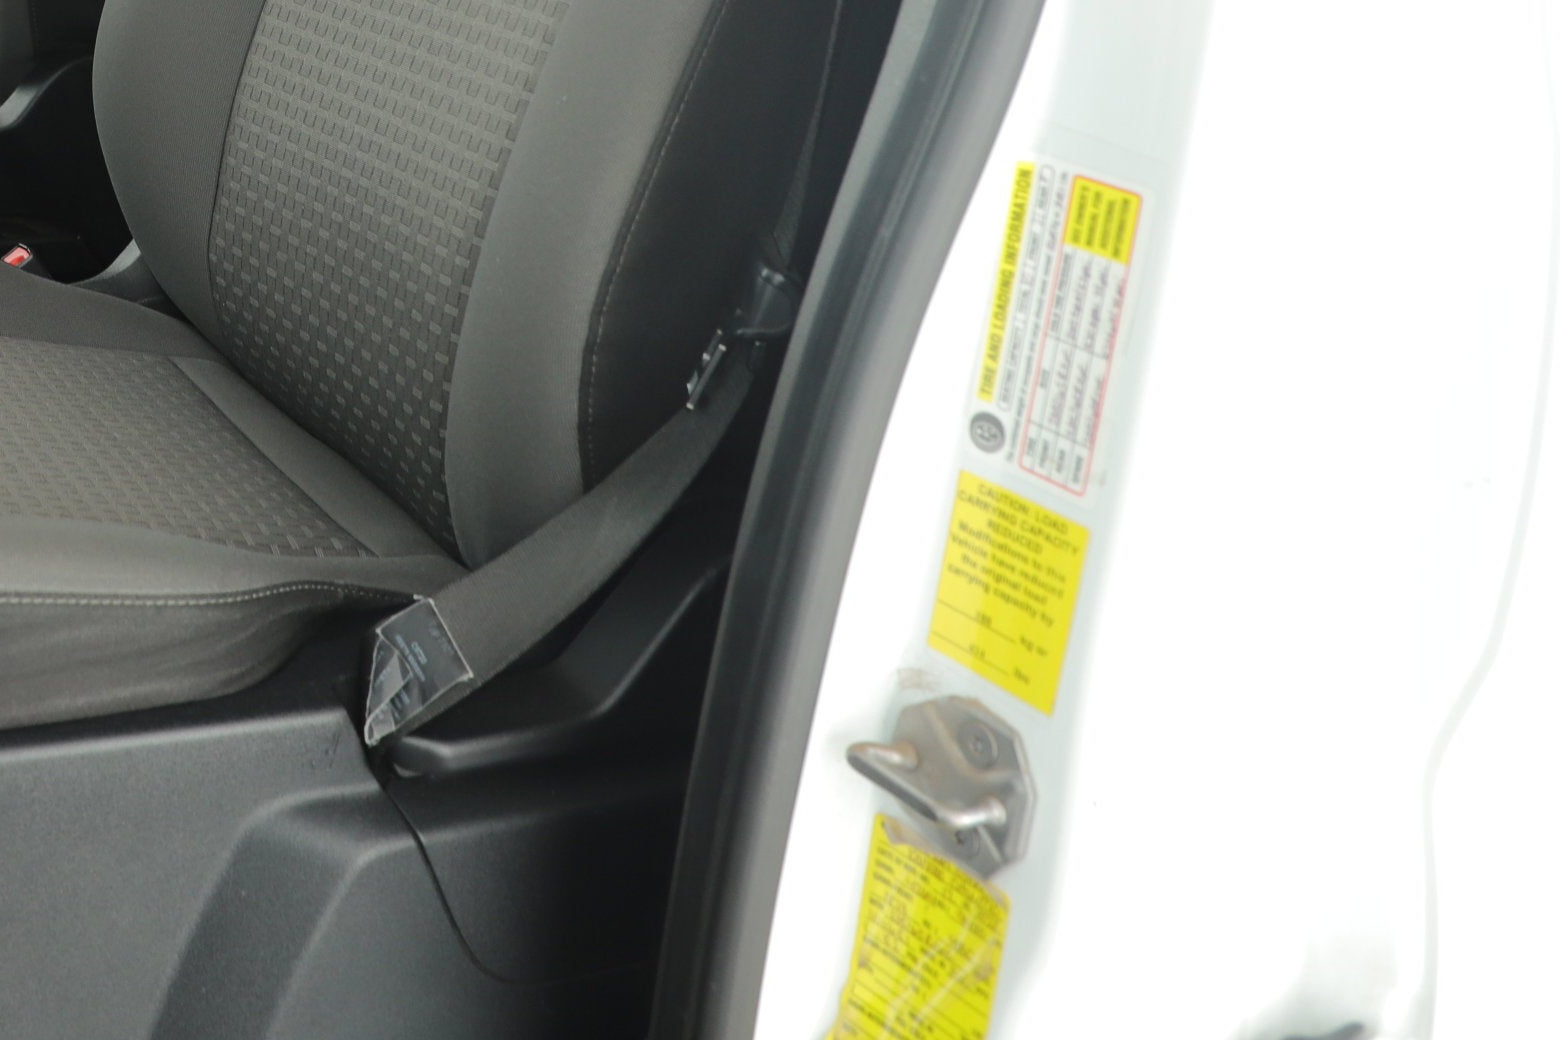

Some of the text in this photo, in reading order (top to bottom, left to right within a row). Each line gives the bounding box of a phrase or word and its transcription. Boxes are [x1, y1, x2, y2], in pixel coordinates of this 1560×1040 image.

[979, 166, 1033, 396] TIRE AND LOADING INFORMATION
[986, 518, 1043, 555] REDUCED
[1019, 519, 1079, 556] CAPACITY
